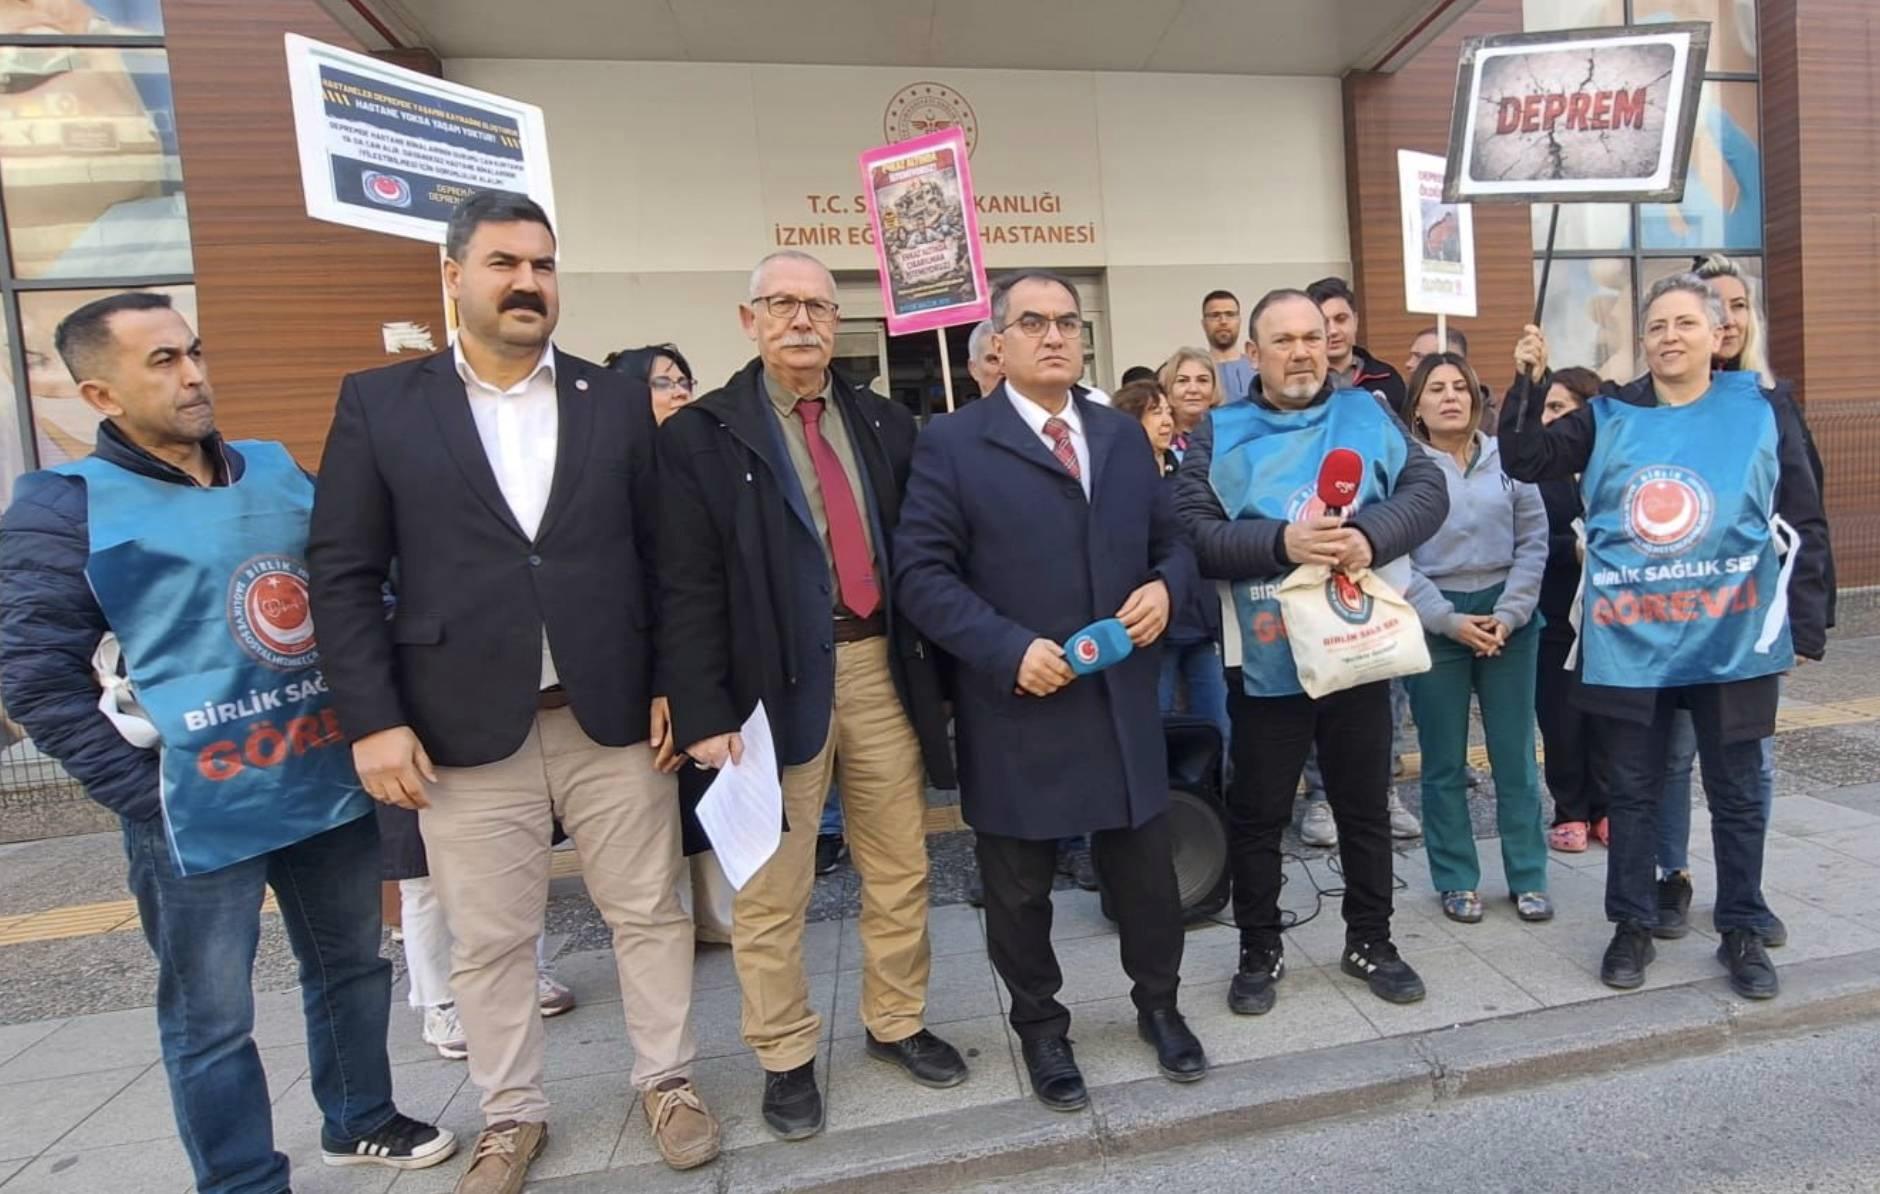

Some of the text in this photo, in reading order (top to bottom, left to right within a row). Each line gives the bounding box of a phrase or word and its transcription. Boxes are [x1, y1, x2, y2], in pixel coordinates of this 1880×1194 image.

[354, 99, 399, 119] HASTANE
[400, 111, 431, 127] YOKSA
[1496, 87, 1646, 135] DEPREM
[807, 192, 1061, 213] T.C. S KANLIĞI
[775, 222, 1095, 246] İZMİR EĞ HASTANESİ
[245, 559, 291, 579] BİRLİK
[1592, 564, 1641, 587] BİRLİK
[1645, 558, 1721, 582] SAĞLIK
[1250, 581, 1281, 601] BİR
[184, 671, 329, 732] BİRLİK SAĞ
[197, 708, 344, 781] GÖRE
